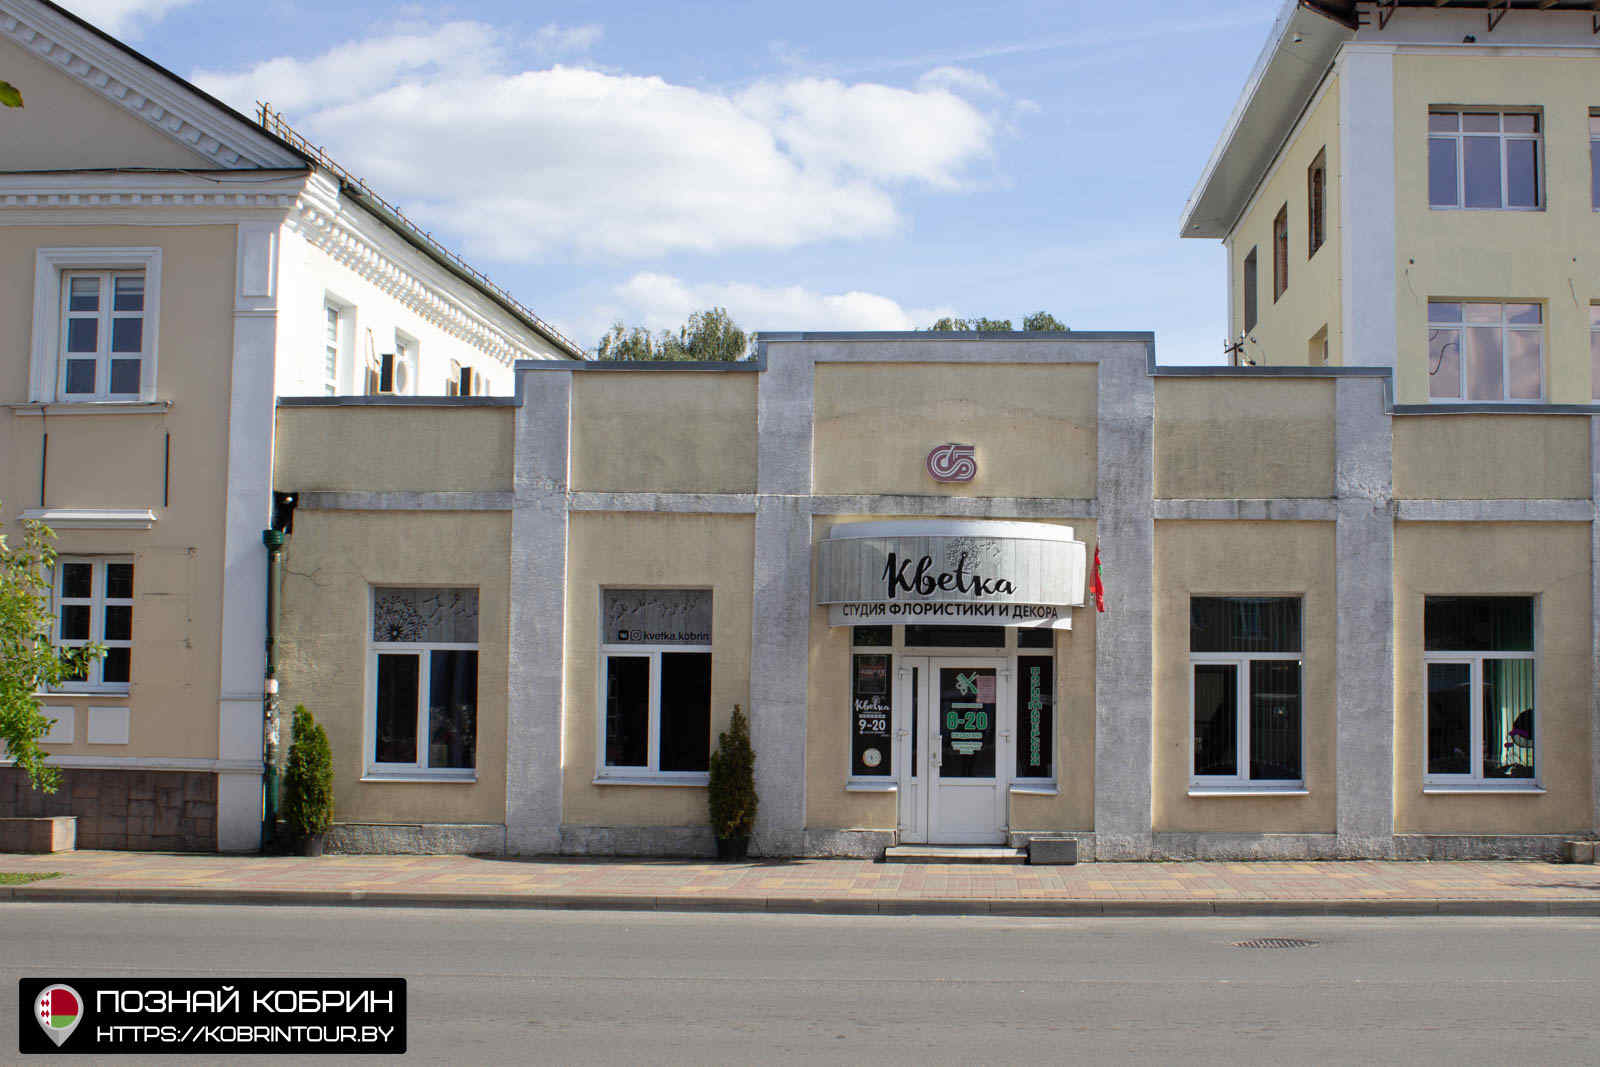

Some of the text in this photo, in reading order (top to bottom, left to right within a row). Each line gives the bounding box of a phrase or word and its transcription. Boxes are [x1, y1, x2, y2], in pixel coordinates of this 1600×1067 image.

[882, 552, 1017, 598] Кветка
[842, 603, 1058, 619] СТУДИЯ ФЛОРИСТИКИ И ДЕКОРА
[858, 719, 887, 731] 9-20
